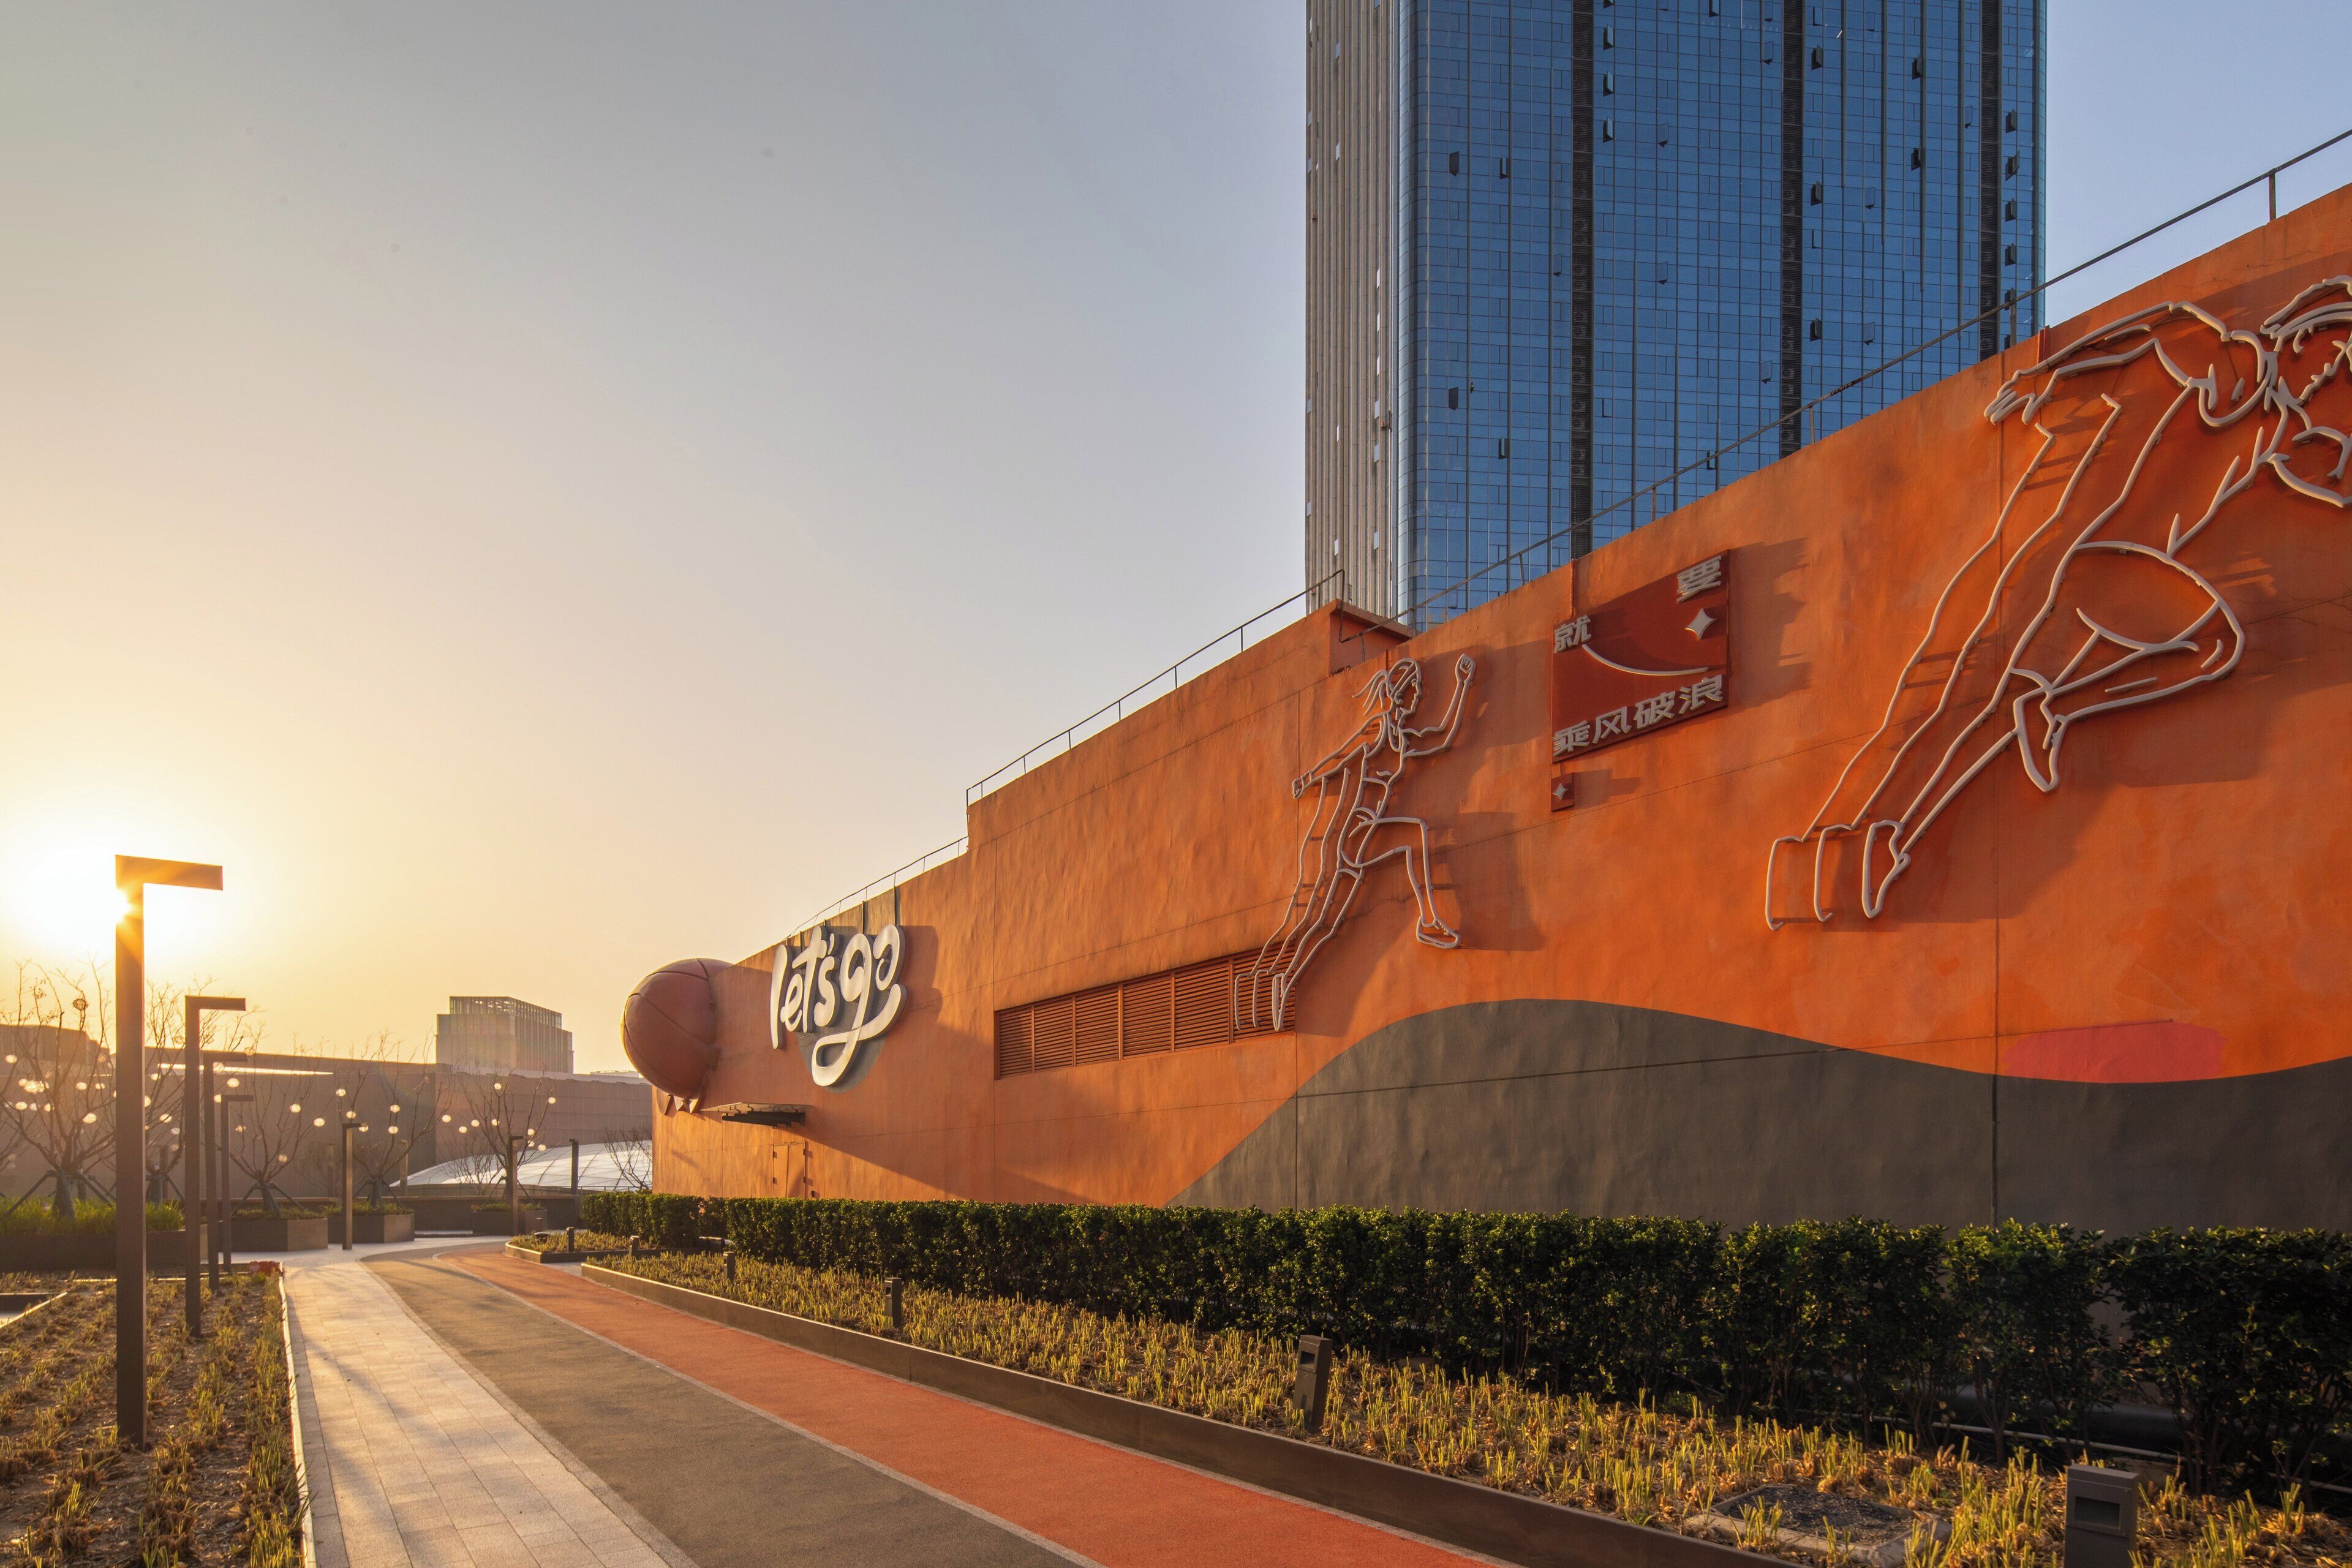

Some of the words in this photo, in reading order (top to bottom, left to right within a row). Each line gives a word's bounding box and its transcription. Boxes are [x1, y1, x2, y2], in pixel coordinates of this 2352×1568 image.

[1553, 614, 1592, 654] 就
[1552, 674, 1723, 757] 乘风破浪
[812, 924, 907, 1087] go
